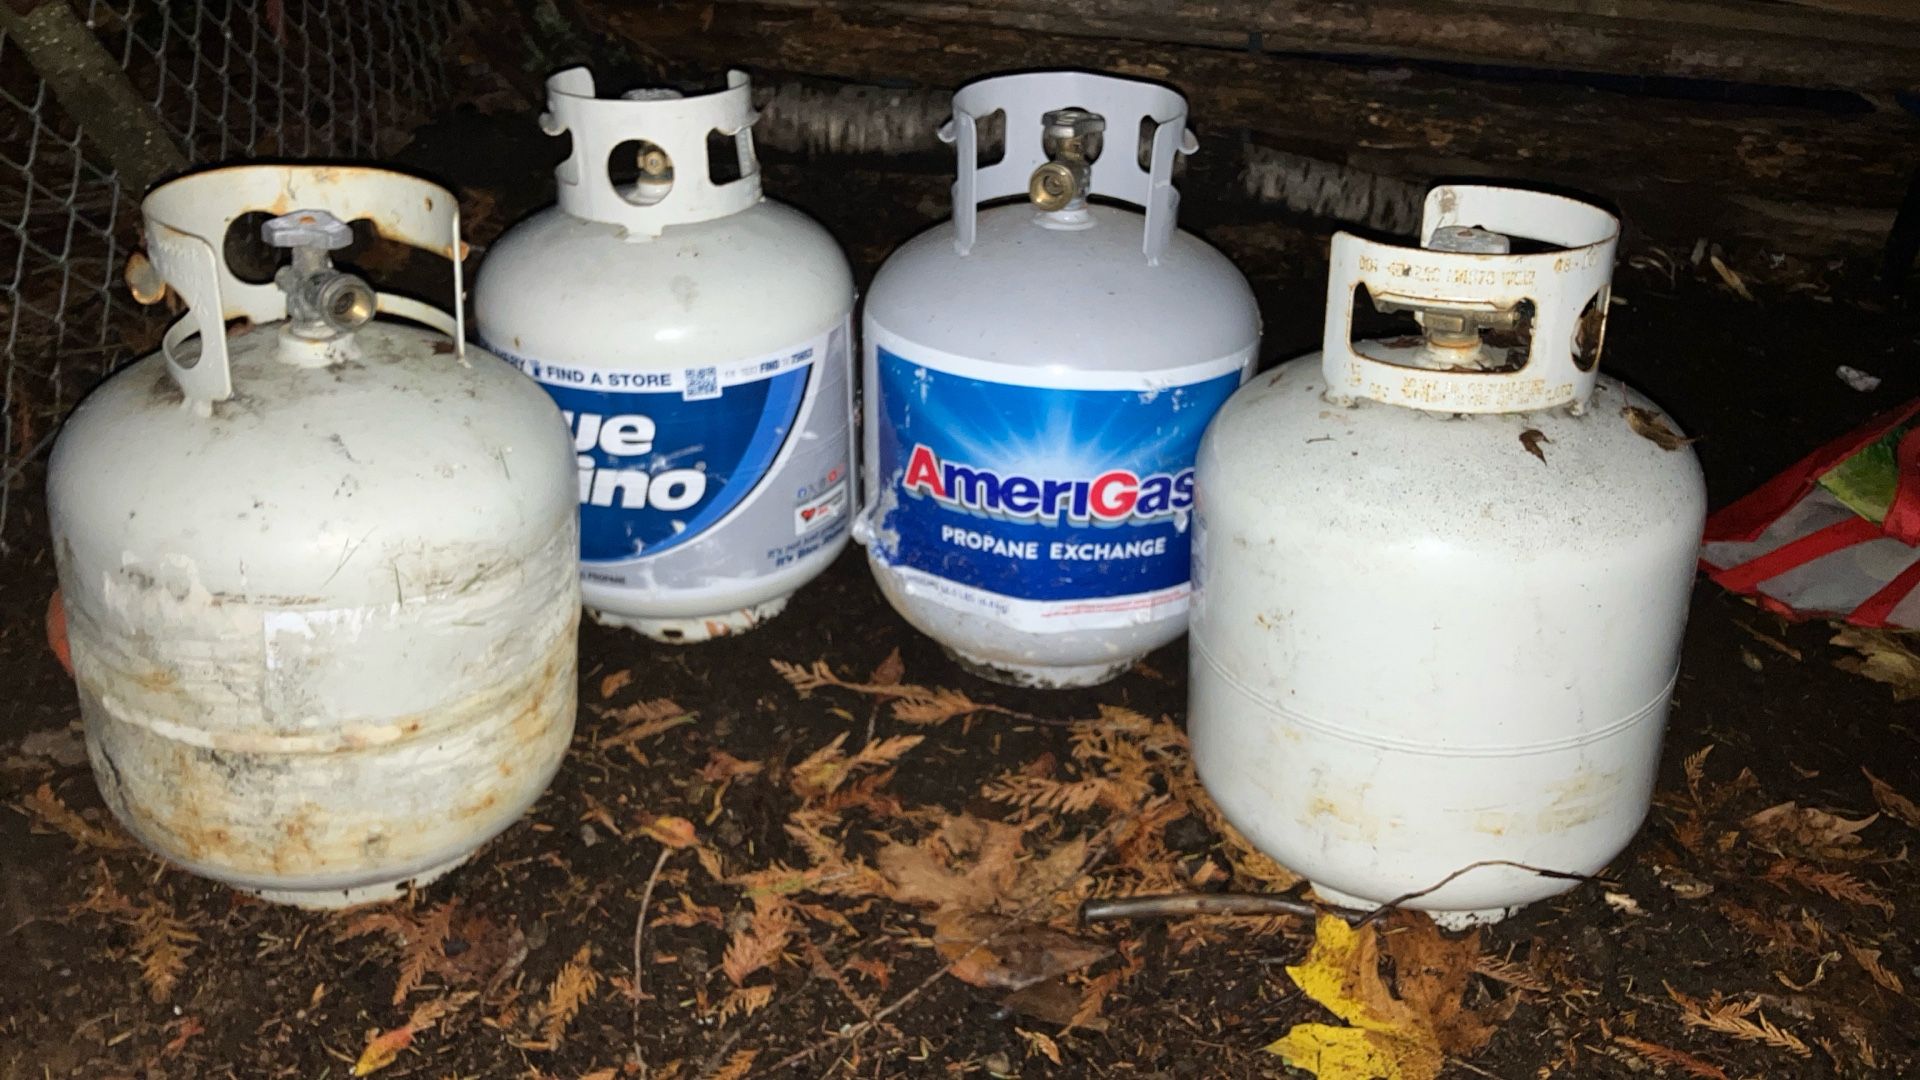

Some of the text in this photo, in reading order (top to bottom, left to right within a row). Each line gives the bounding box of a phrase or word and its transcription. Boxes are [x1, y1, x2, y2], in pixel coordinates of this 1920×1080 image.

[547, 365, 671, 387] FIND A STORE
[562, 409, 656, 457] ue
[577, 454, 707, 512] ino
[904, 444, 1194, 522] AmeriGas
[941, 525, 1167, 560] PROPANE EXCHANGE
